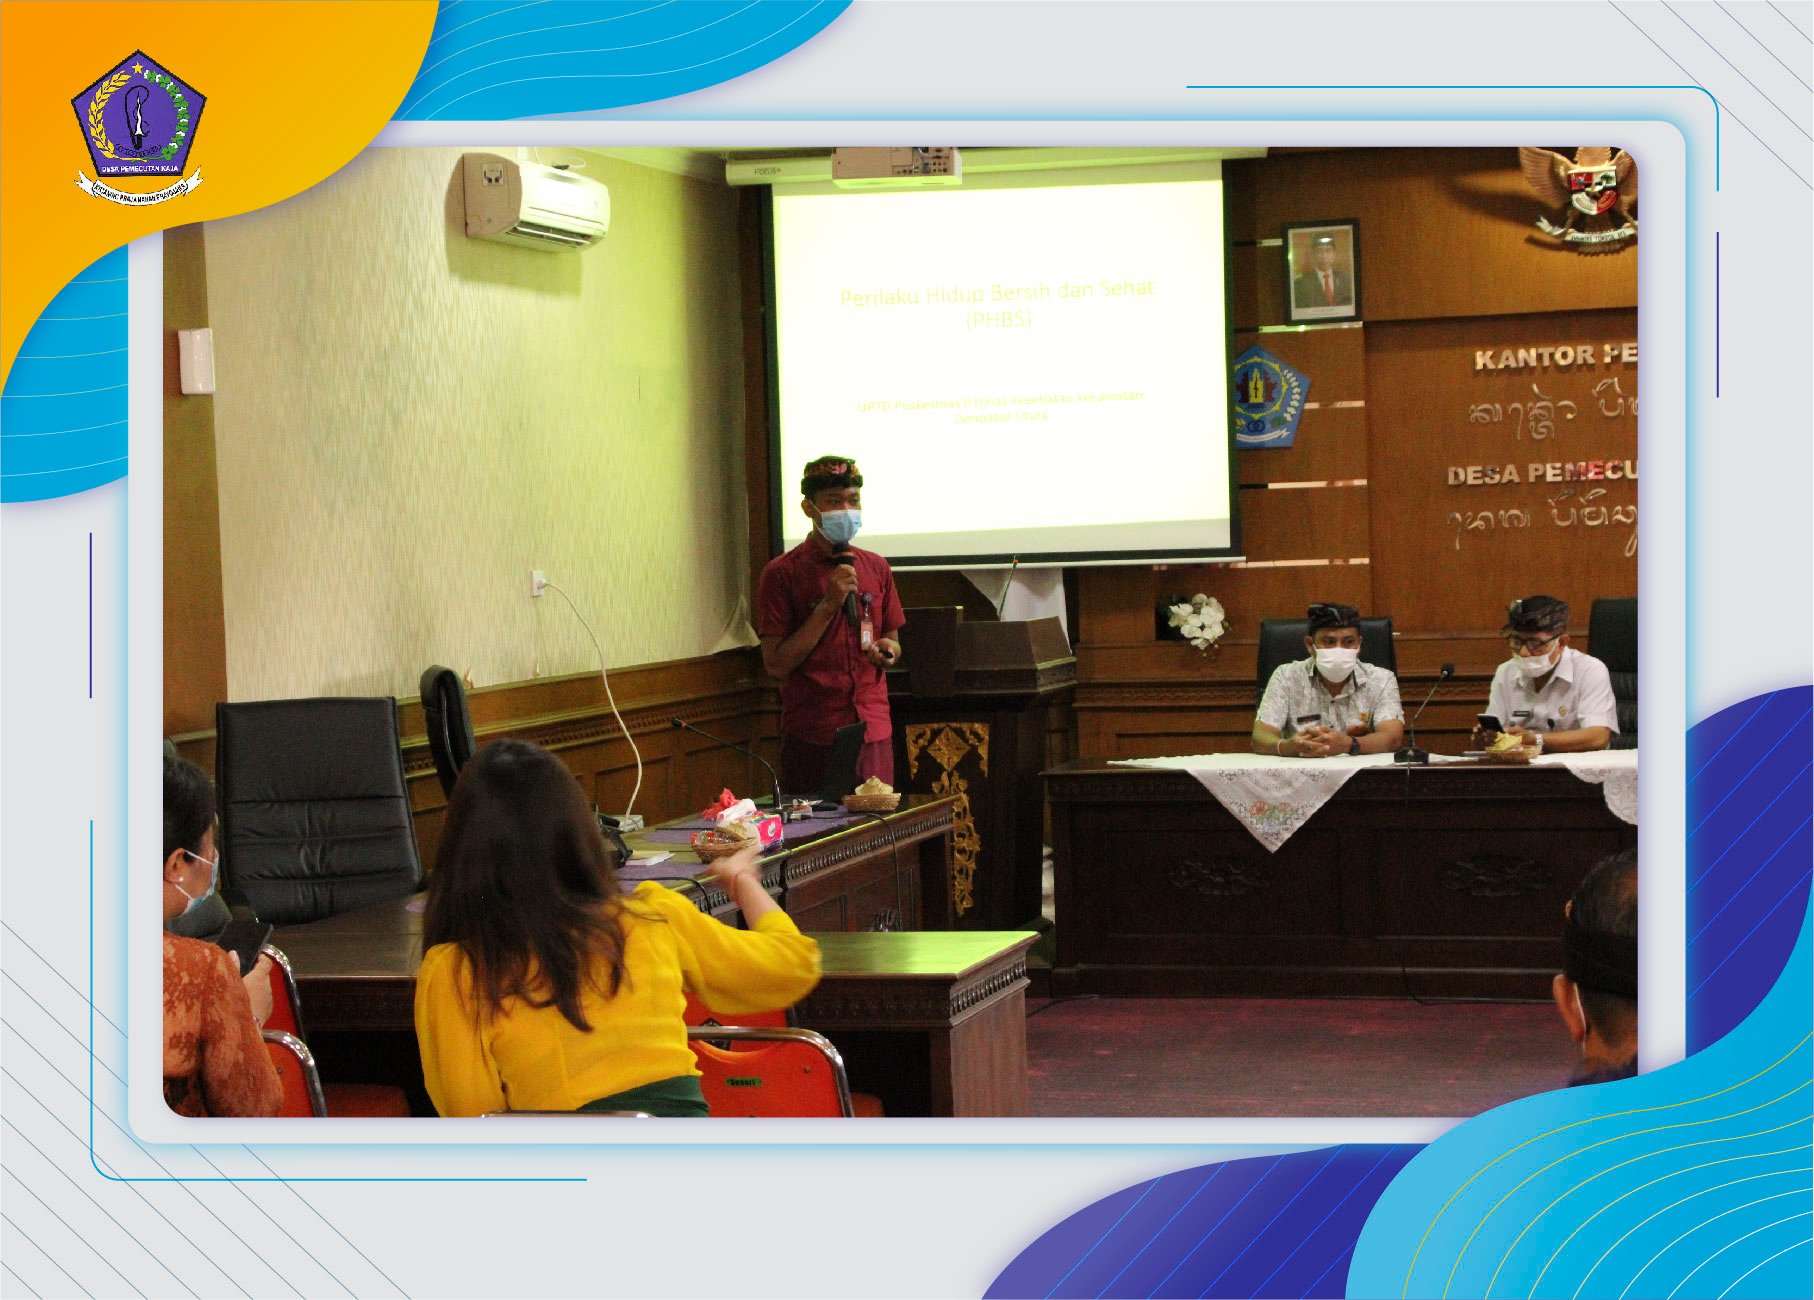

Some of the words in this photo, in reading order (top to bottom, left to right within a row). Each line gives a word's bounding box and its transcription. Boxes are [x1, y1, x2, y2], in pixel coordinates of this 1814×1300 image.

[841, 287, 919, 307] Perilaku
[926, 286, 985, 306] Hidup
[991, 283, 1050, 302] Bersih
[1057, 281, 1094, 299] dan
[1100, 278, 1155, 298] Sehat
[966, 309, 1032, 334] (PHBS)
[1475, 345, 1596, 371] KANTOR
[1448, 464, 1521, 486] DESA
[1528, 459, 1638, 484] PEMECU
